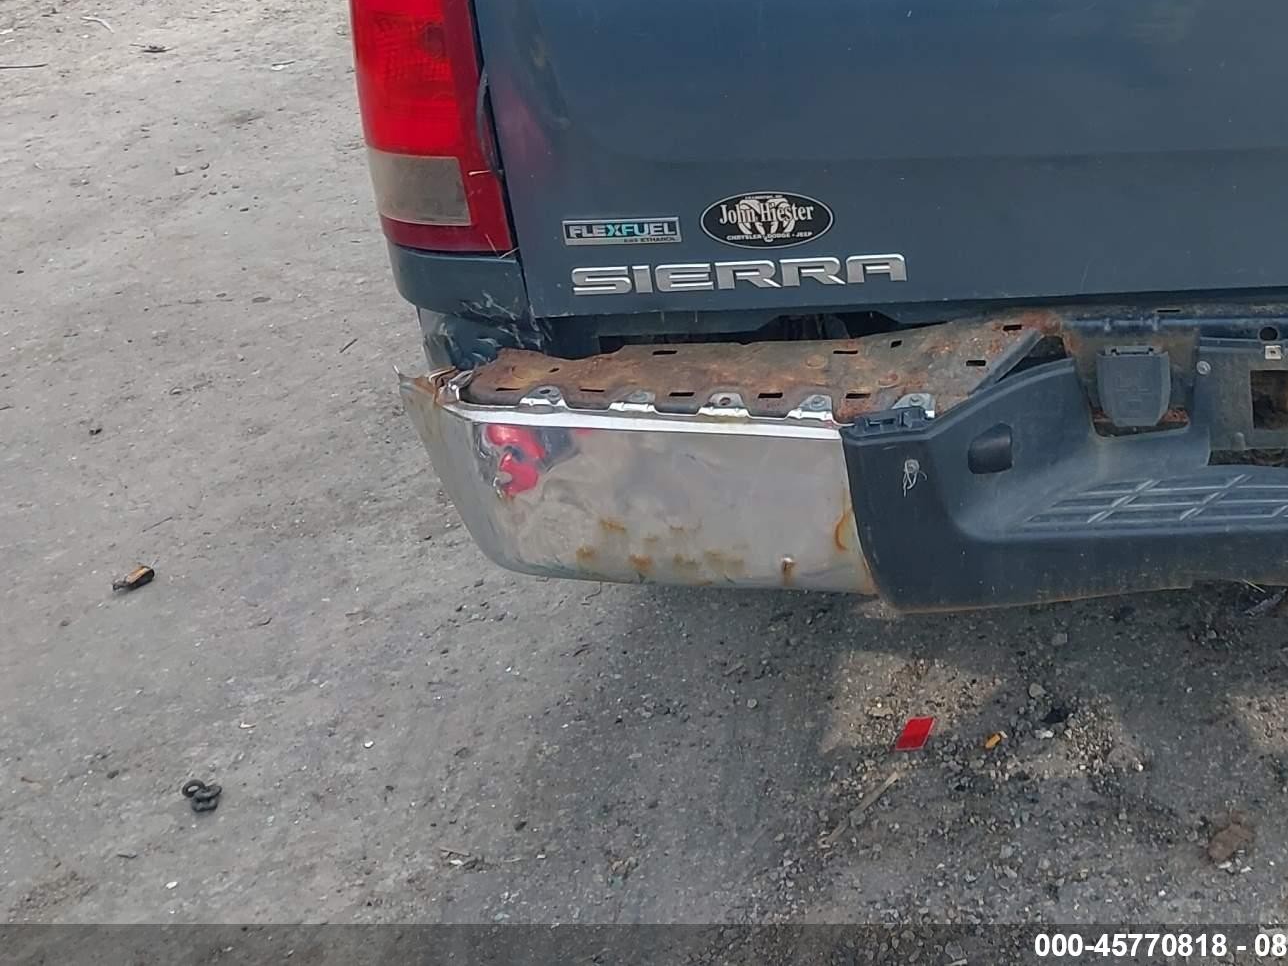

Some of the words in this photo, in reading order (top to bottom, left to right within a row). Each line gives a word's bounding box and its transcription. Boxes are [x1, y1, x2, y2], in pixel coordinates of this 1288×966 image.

[719, 204, 756, 224] John
[760, 202, 814, 222] Hiester
[568, 222, 676, 239] FLEXFUEL
[571, 252, 908, 296] SIERRA
